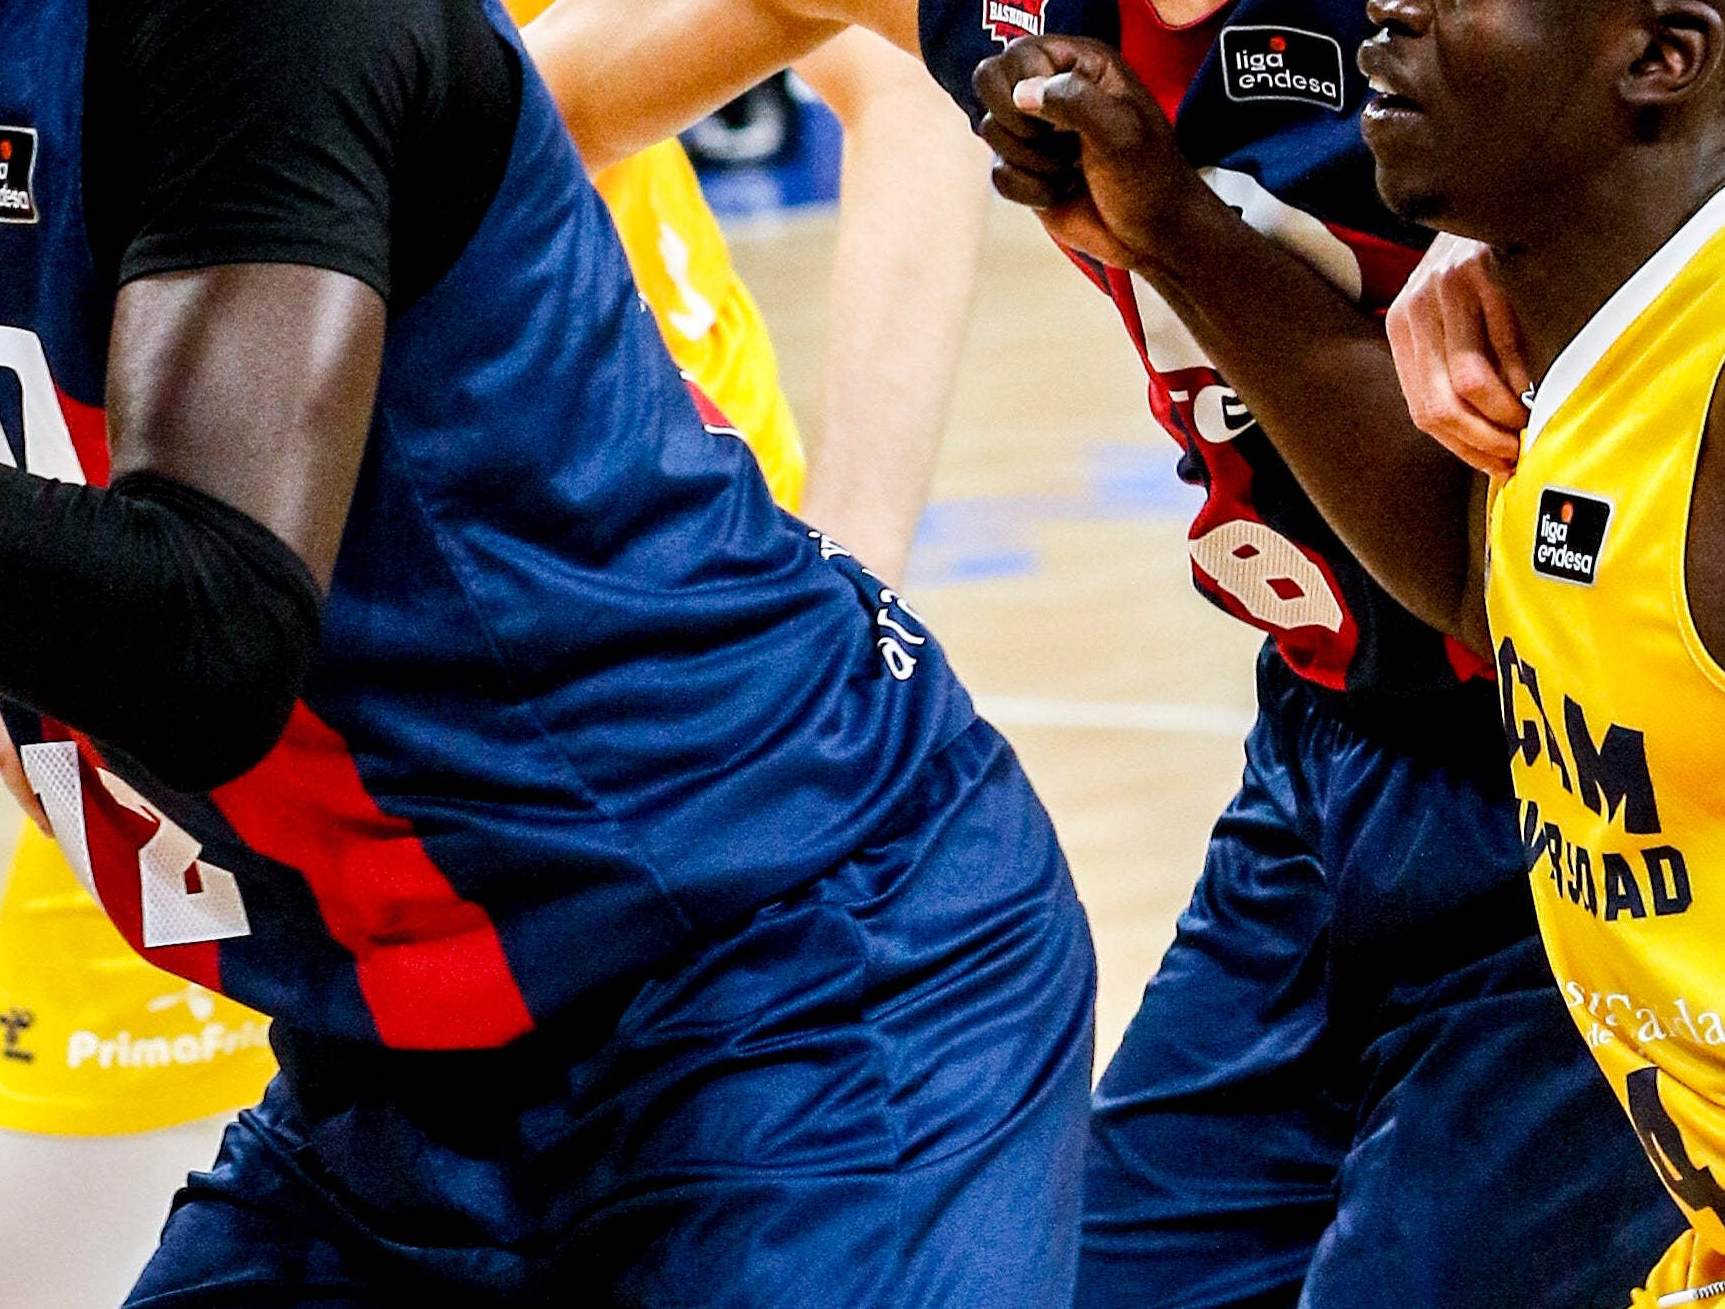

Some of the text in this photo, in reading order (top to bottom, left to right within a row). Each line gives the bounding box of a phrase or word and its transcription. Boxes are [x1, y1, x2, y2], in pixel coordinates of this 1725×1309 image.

[989, 0, 1039, 36] BASKONIA
[1235, 49, 1284, 71] liga
[1238, 69, 1337, 99] endesa
[1540, 514, 1568, 543] liga
[1537, 544, 1594, 575] endesa
